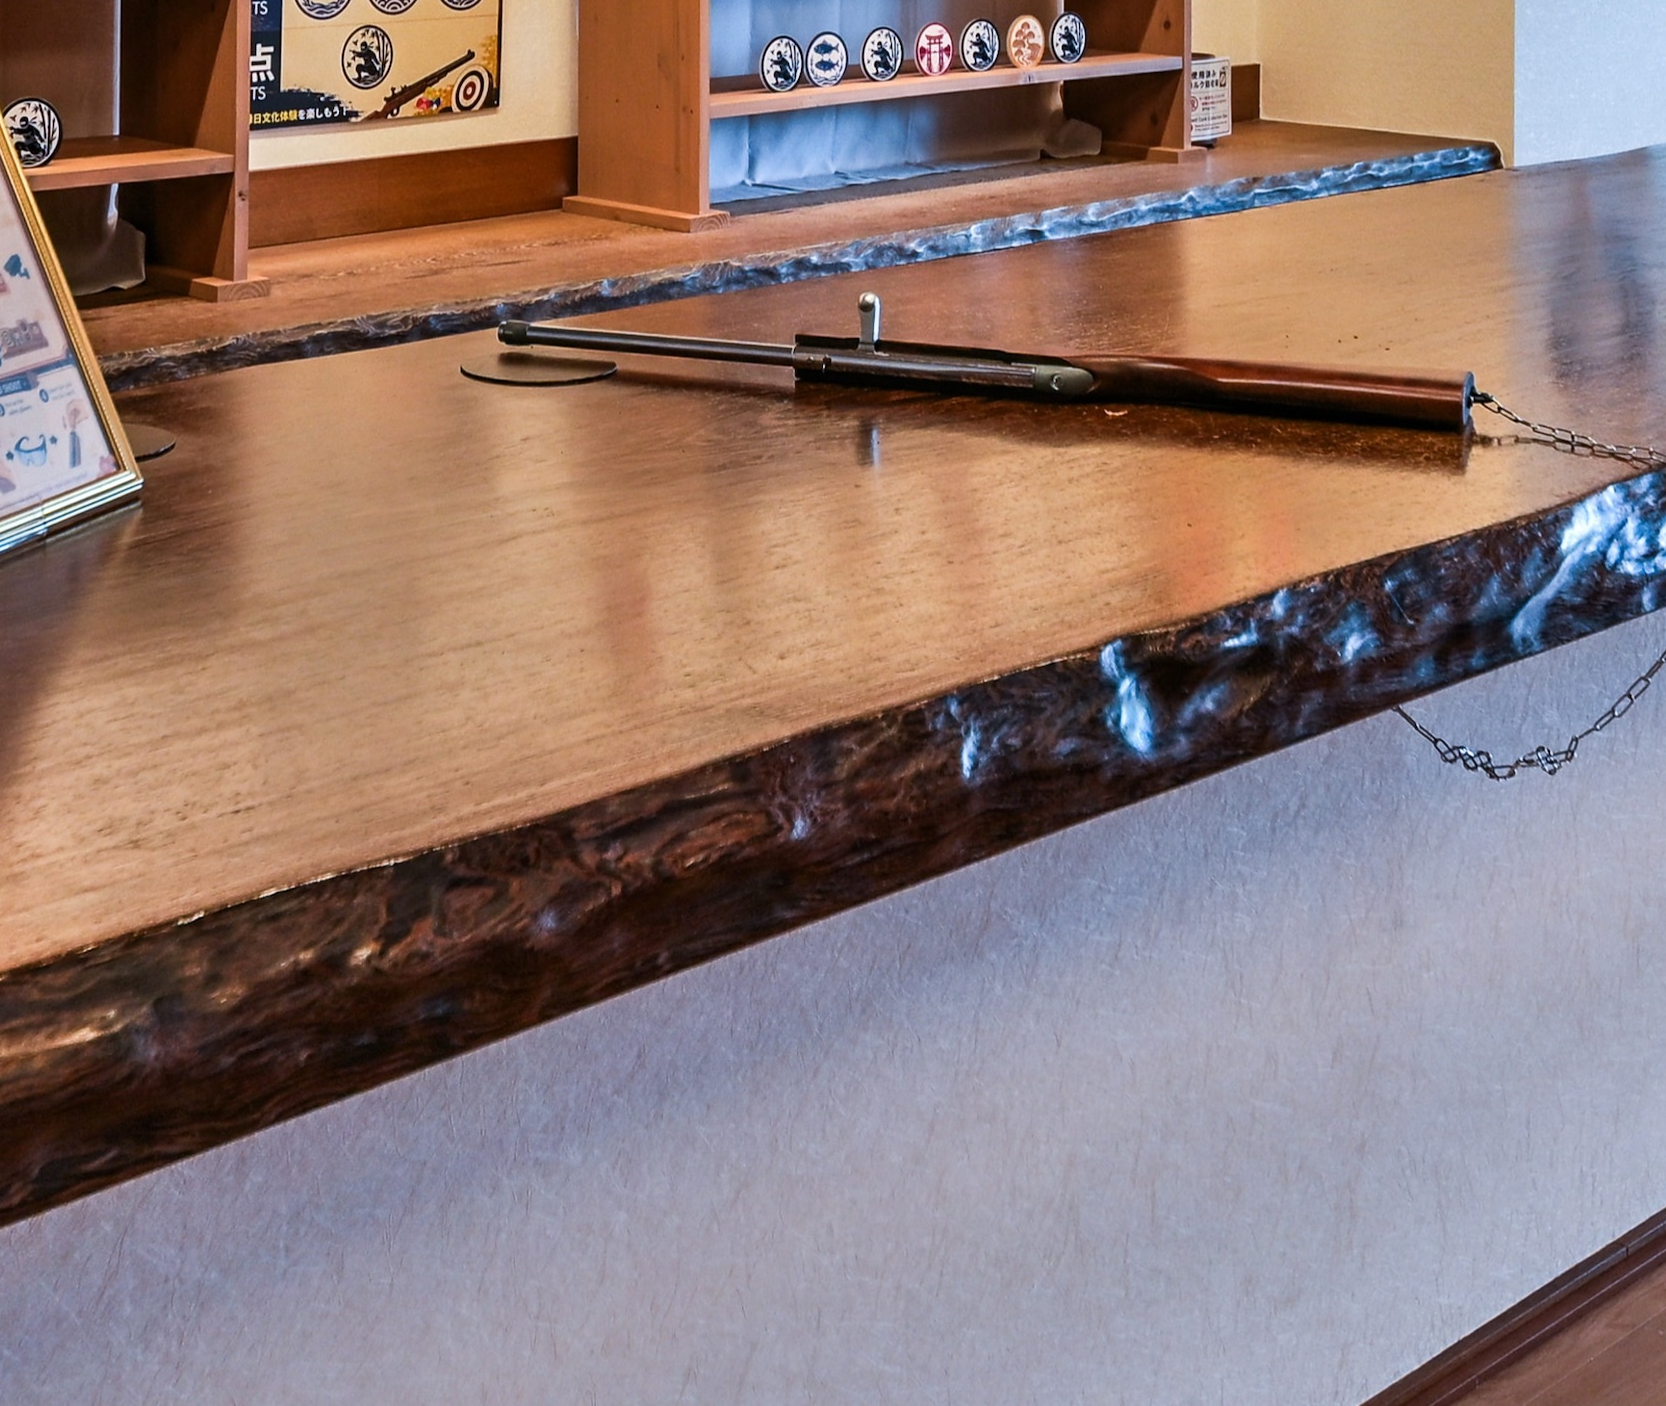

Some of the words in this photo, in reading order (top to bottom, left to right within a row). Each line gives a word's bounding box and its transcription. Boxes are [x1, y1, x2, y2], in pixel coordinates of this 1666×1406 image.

[249, 106, 347, 125] 日文化体験を楽しもう！
